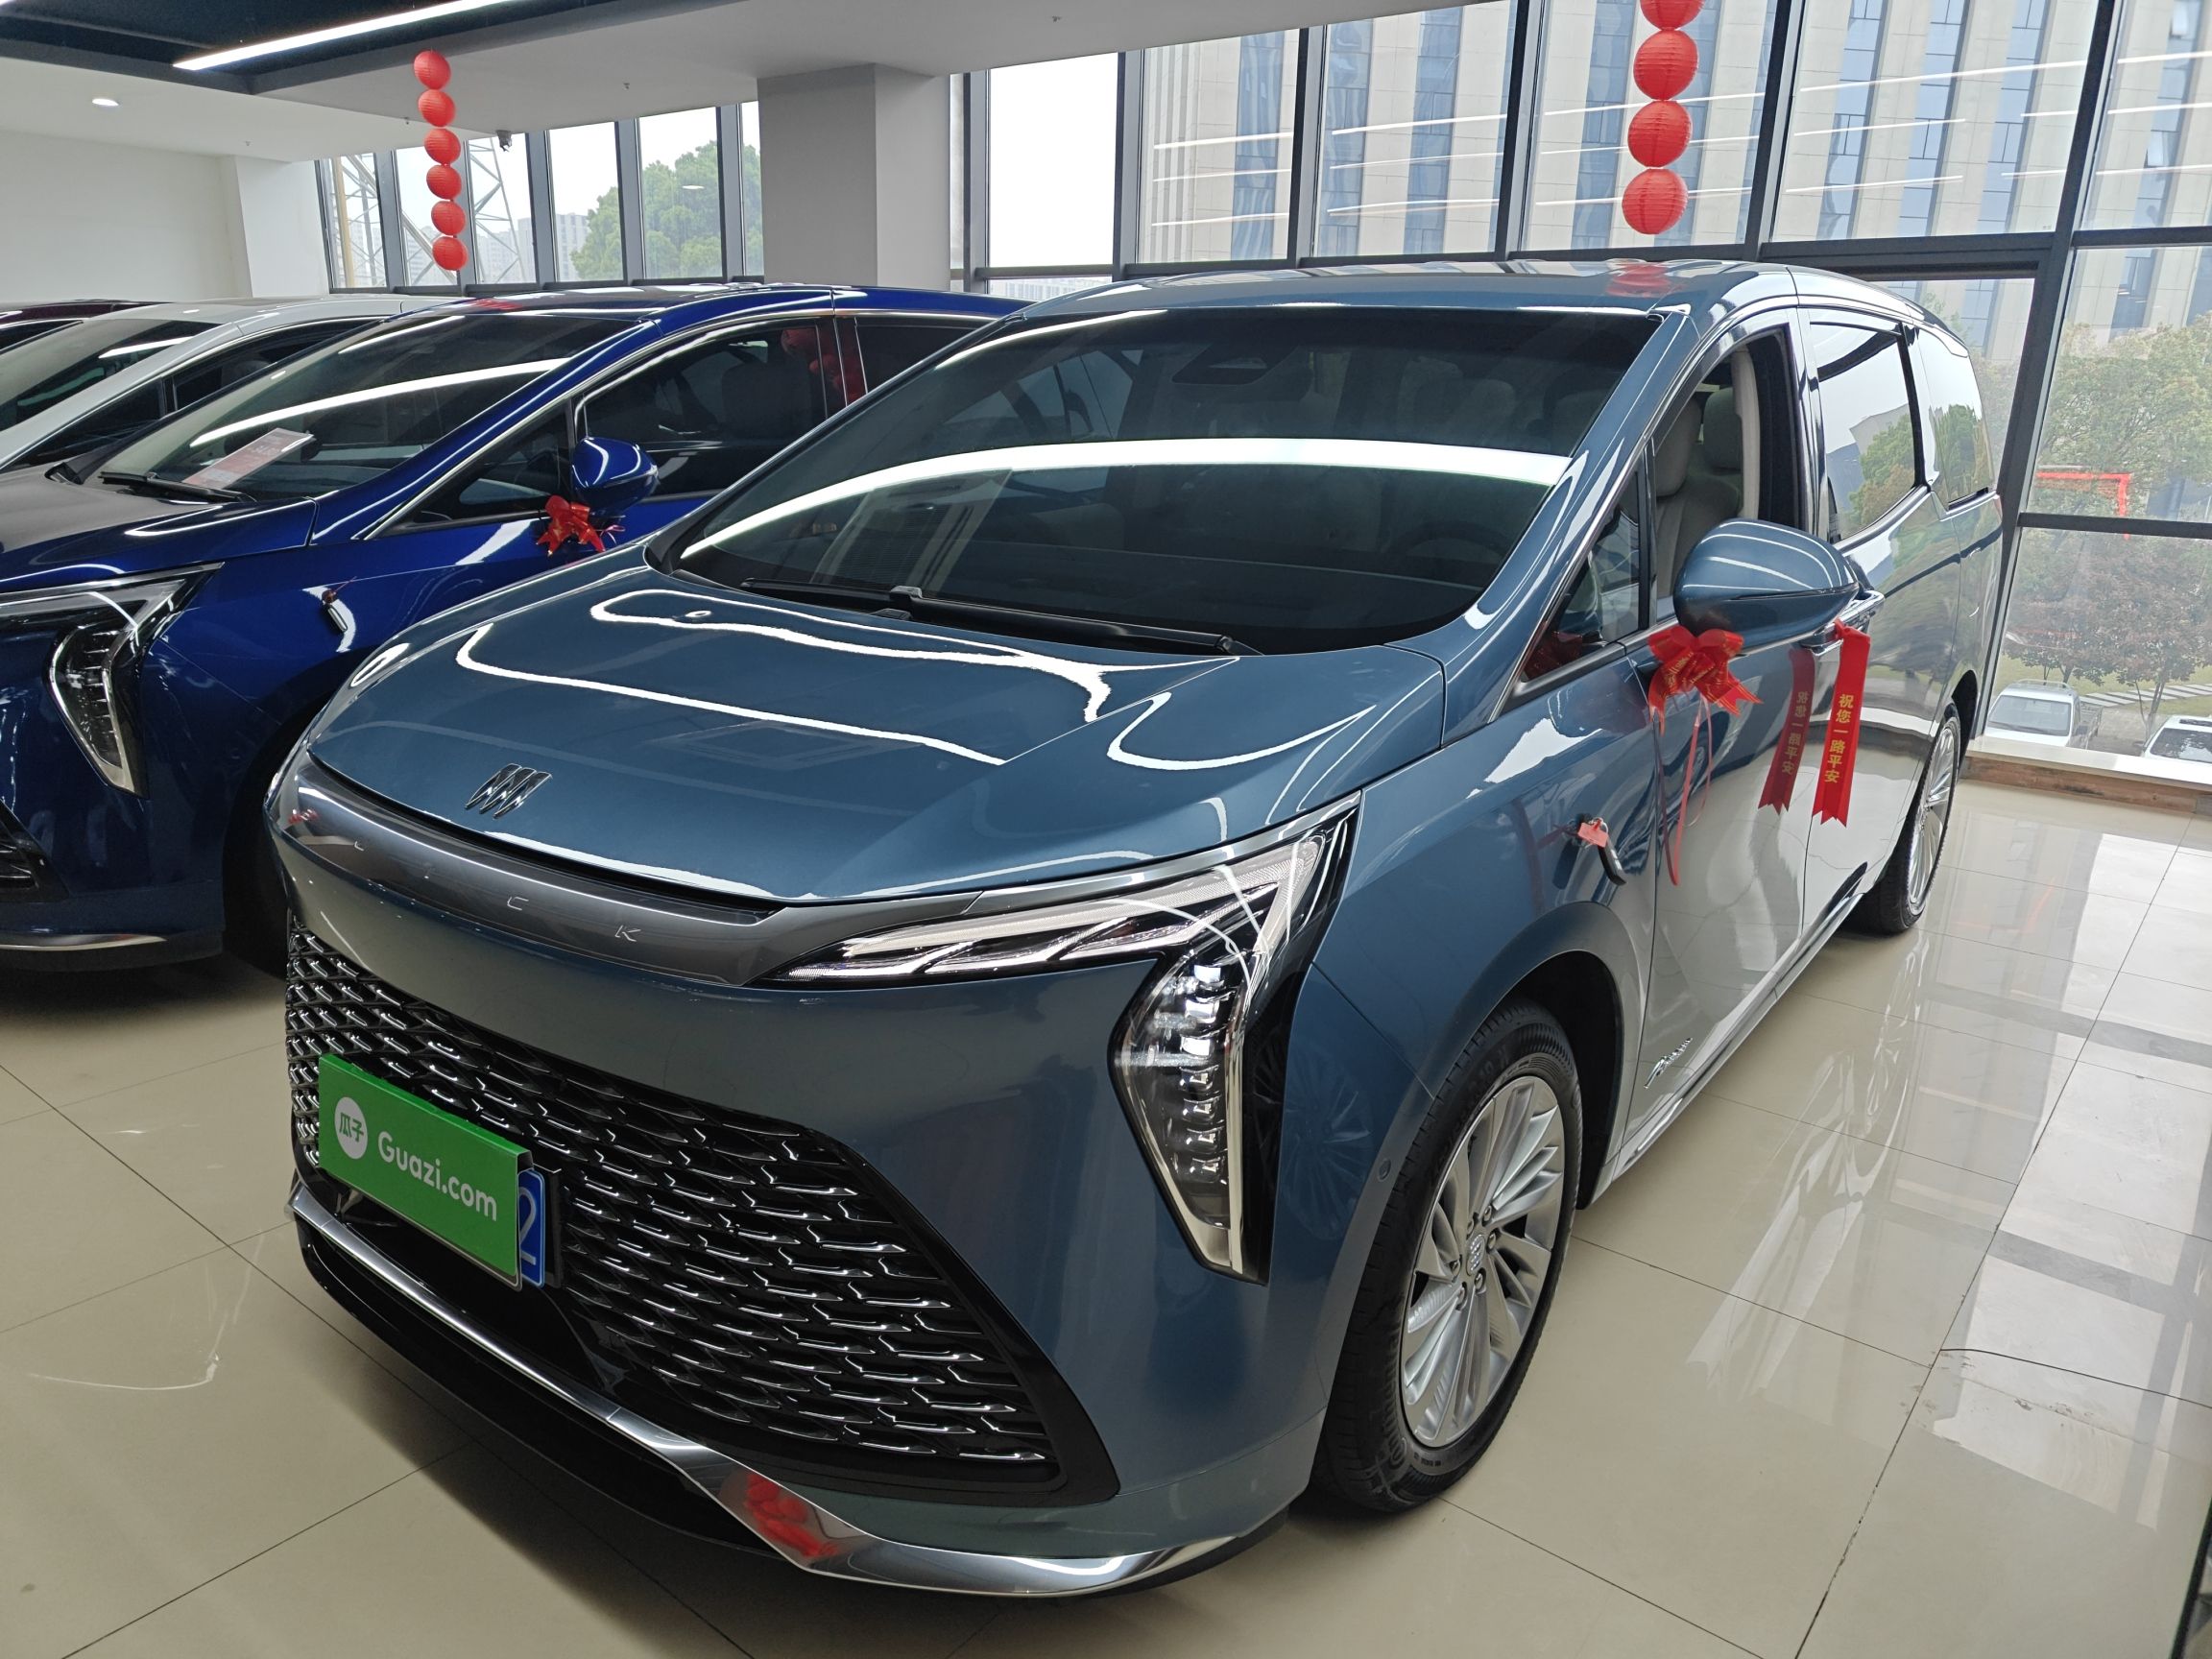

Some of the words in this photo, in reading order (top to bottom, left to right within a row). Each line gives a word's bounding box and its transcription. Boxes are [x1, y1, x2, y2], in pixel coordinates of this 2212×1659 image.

[1825, 694, 1854, 782] 祝您一路平安
[339, 1112, 364, 1142] 瓜子
[377, 1130, 497, 1222] Guazi.com
